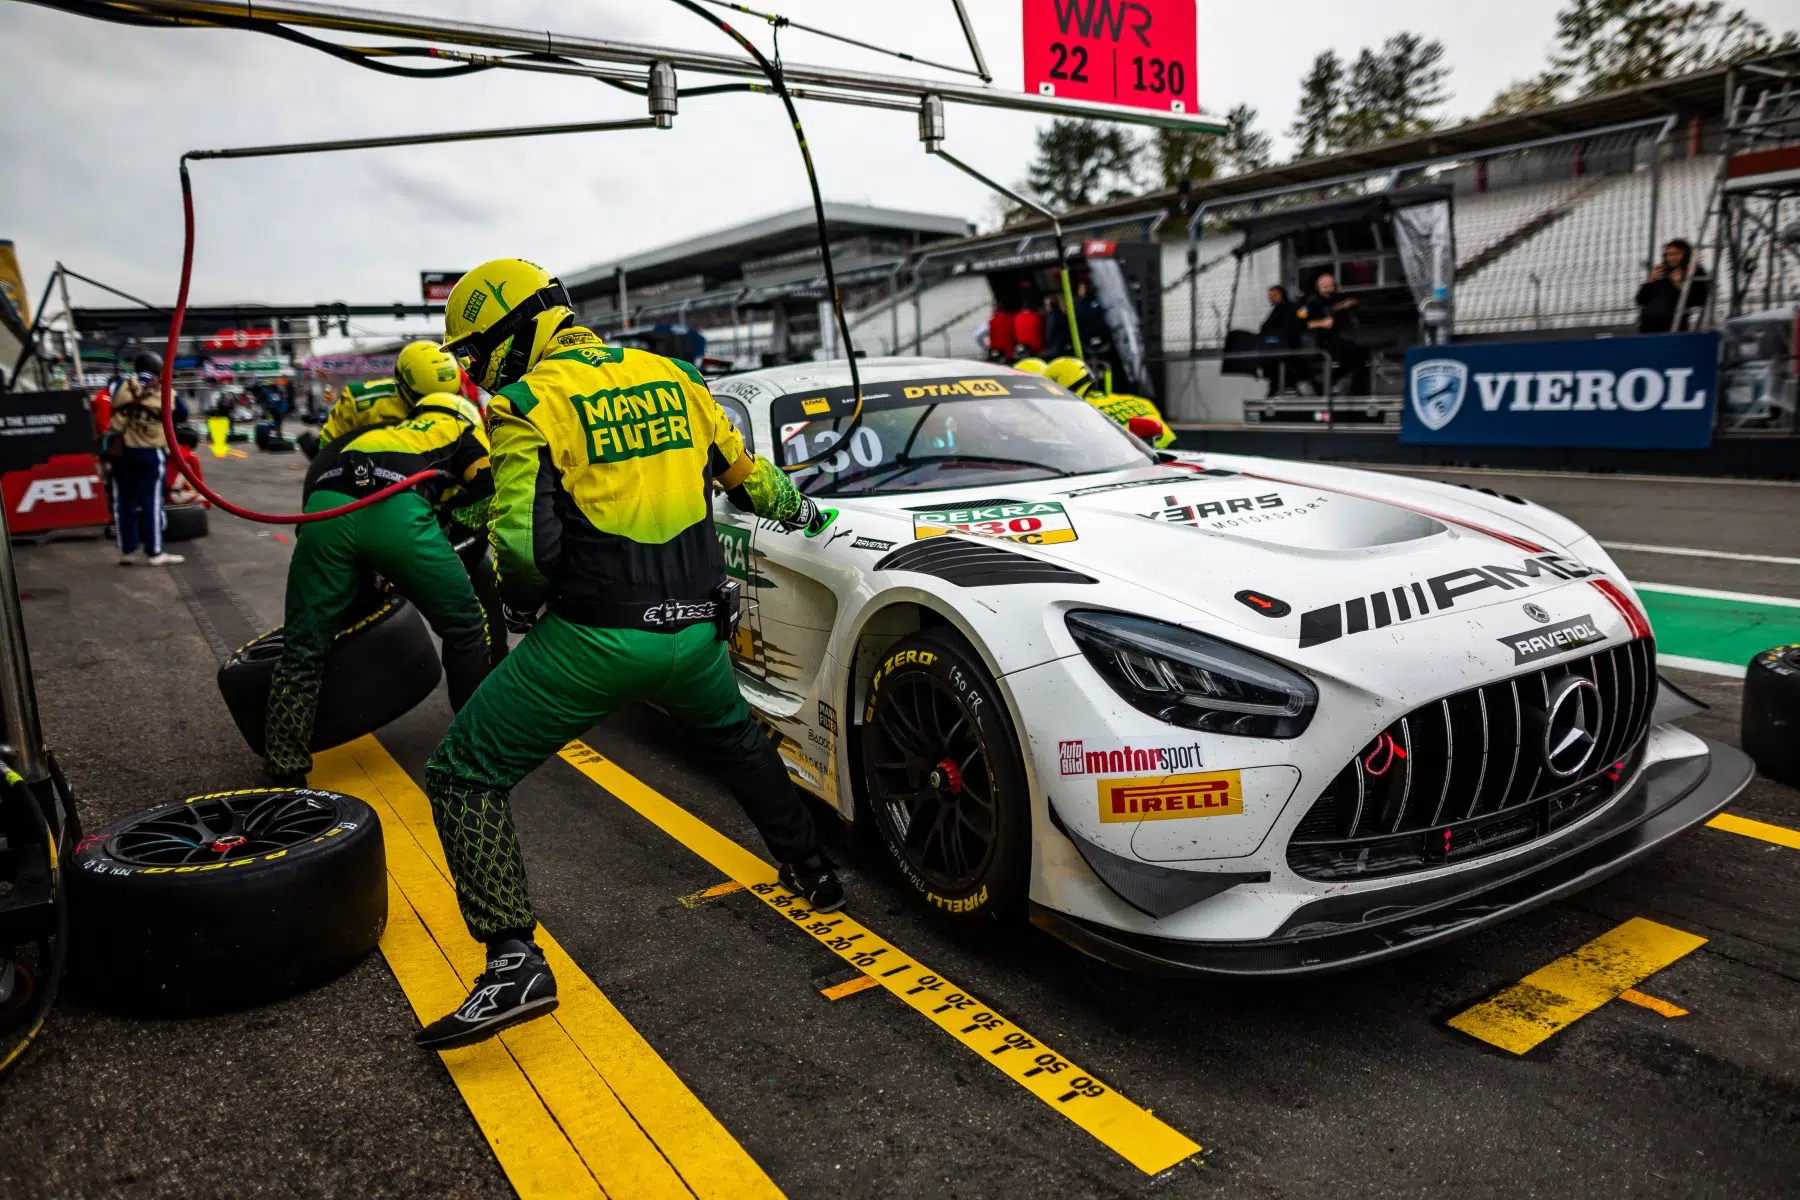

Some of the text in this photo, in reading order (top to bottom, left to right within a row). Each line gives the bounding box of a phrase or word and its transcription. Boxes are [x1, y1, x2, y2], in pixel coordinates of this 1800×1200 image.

[1050, 42, 1185, 96] 22 130
[582, 387, 682, 426] MANN
[904, 385, 964, 400] DTM
[973, 381, 1002, 395] 40
[1473, 367, 1706, 412] VIEROL
[592, 415, 691, 457] FILTER
[783, 425, 883, 476] 130
[16, 475, 100, 513] ABT
[920, 504, 1059, 521] DEKRA
[1211, 496, 1329, 530] MOTORSPORT
[855, 539, 890, 549] RAVENOL
[1427, 556, 1605, 610] AMG
[884, 650, 938, 676] ZERO
[1060, 743, 1082, 759] Auto
[1062, 758, 1082, 774] Bild
[1111, 780, 1230, 814] PIRELLI
[926, 884, 988, 912] PIRELLI
[751, 883, 774, 895] 60
[769, 895, 792, 908] 50
[806, 922, 832, 935] 30
[826, 936, 853, 951] 20
[850, 952, 876, 967] 10
[918, 975, 945, 992] 10
[944, 993, 977, 1010] 20
[972, 1012, 1005, 1031] 30
[1003, 1032, 1037, 1051] 40
[1034, 1053, 1069, 1075] 50
[1069, 1076, 1106, 1098] 60
